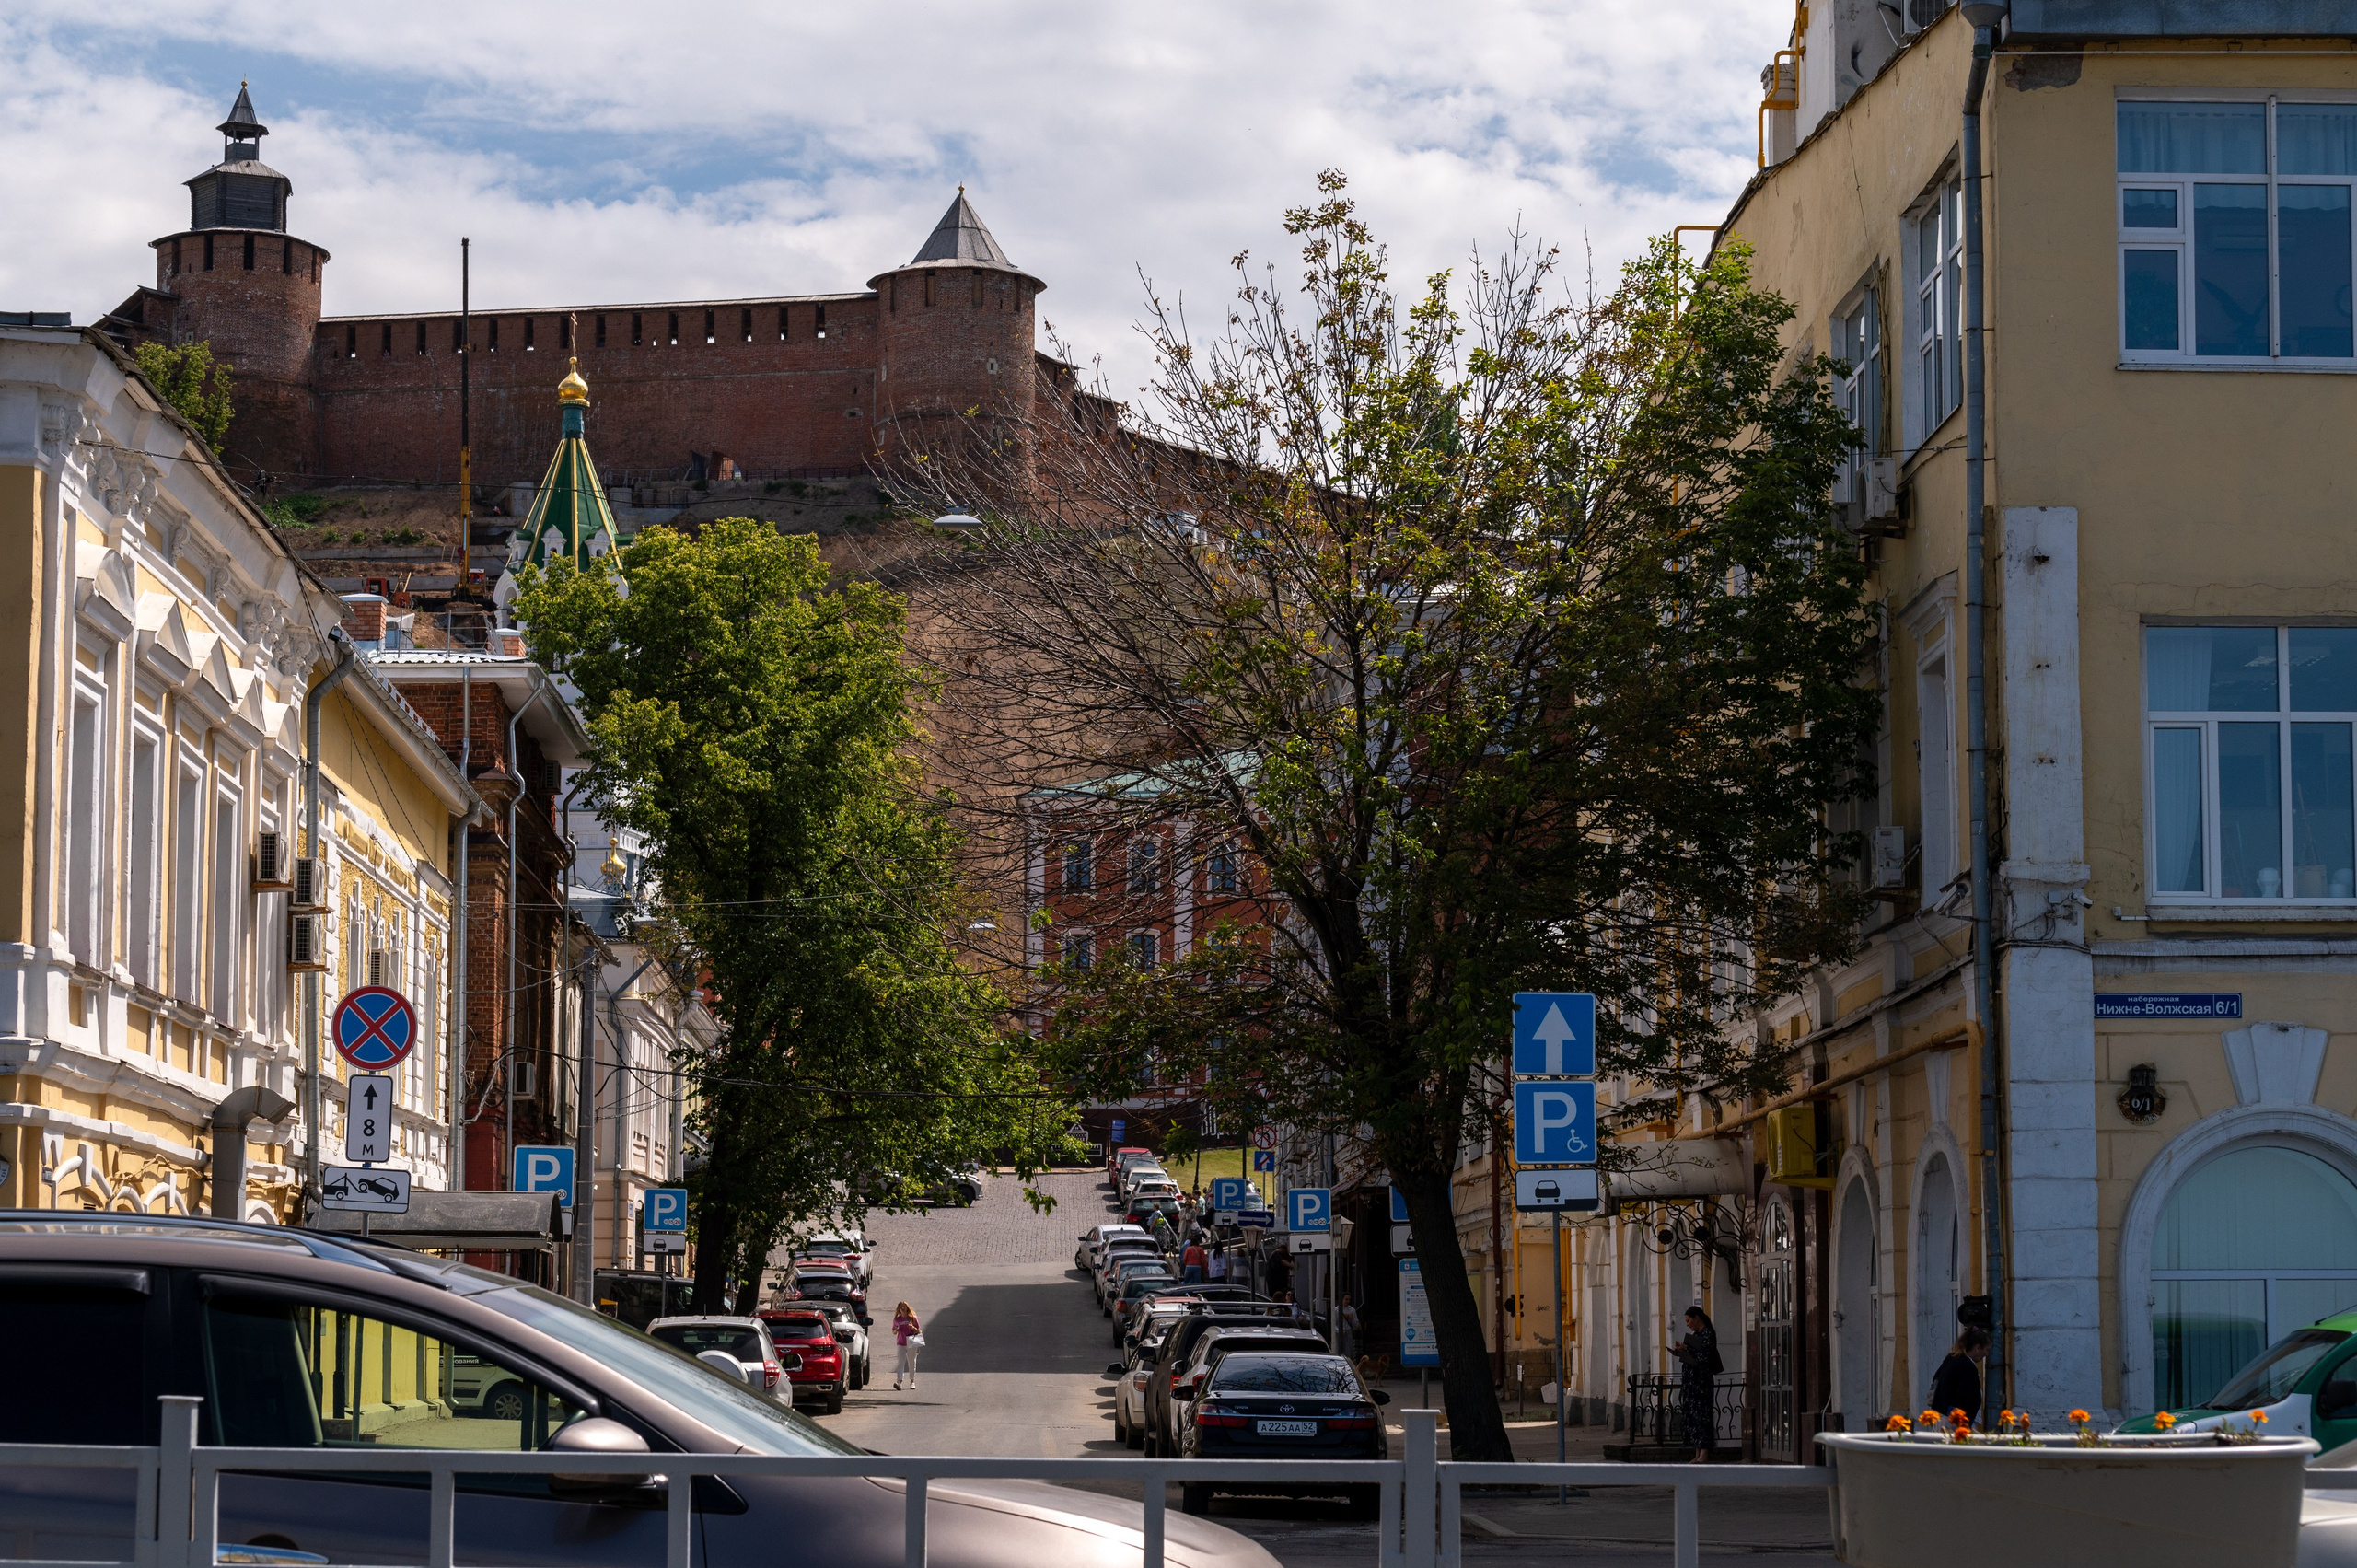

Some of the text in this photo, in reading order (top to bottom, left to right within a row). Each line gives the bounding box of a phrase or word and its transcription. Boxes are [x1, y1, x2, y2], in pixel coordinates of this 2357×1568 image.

[2096, 1001, 2237, 1016] Нижне-Волжская 6/1
[2131, 1094, 2151, 1112] 6/1
[363, 1119, 375, 1136] 8
[1533, 1091, 1577, 1154] P
[528, 1154, 561, 1191] P
[1221, 1182, 1238, 1206] P
[653, 1193, 677, 1225] P
[1297, 1194, 1321, 1226] P
